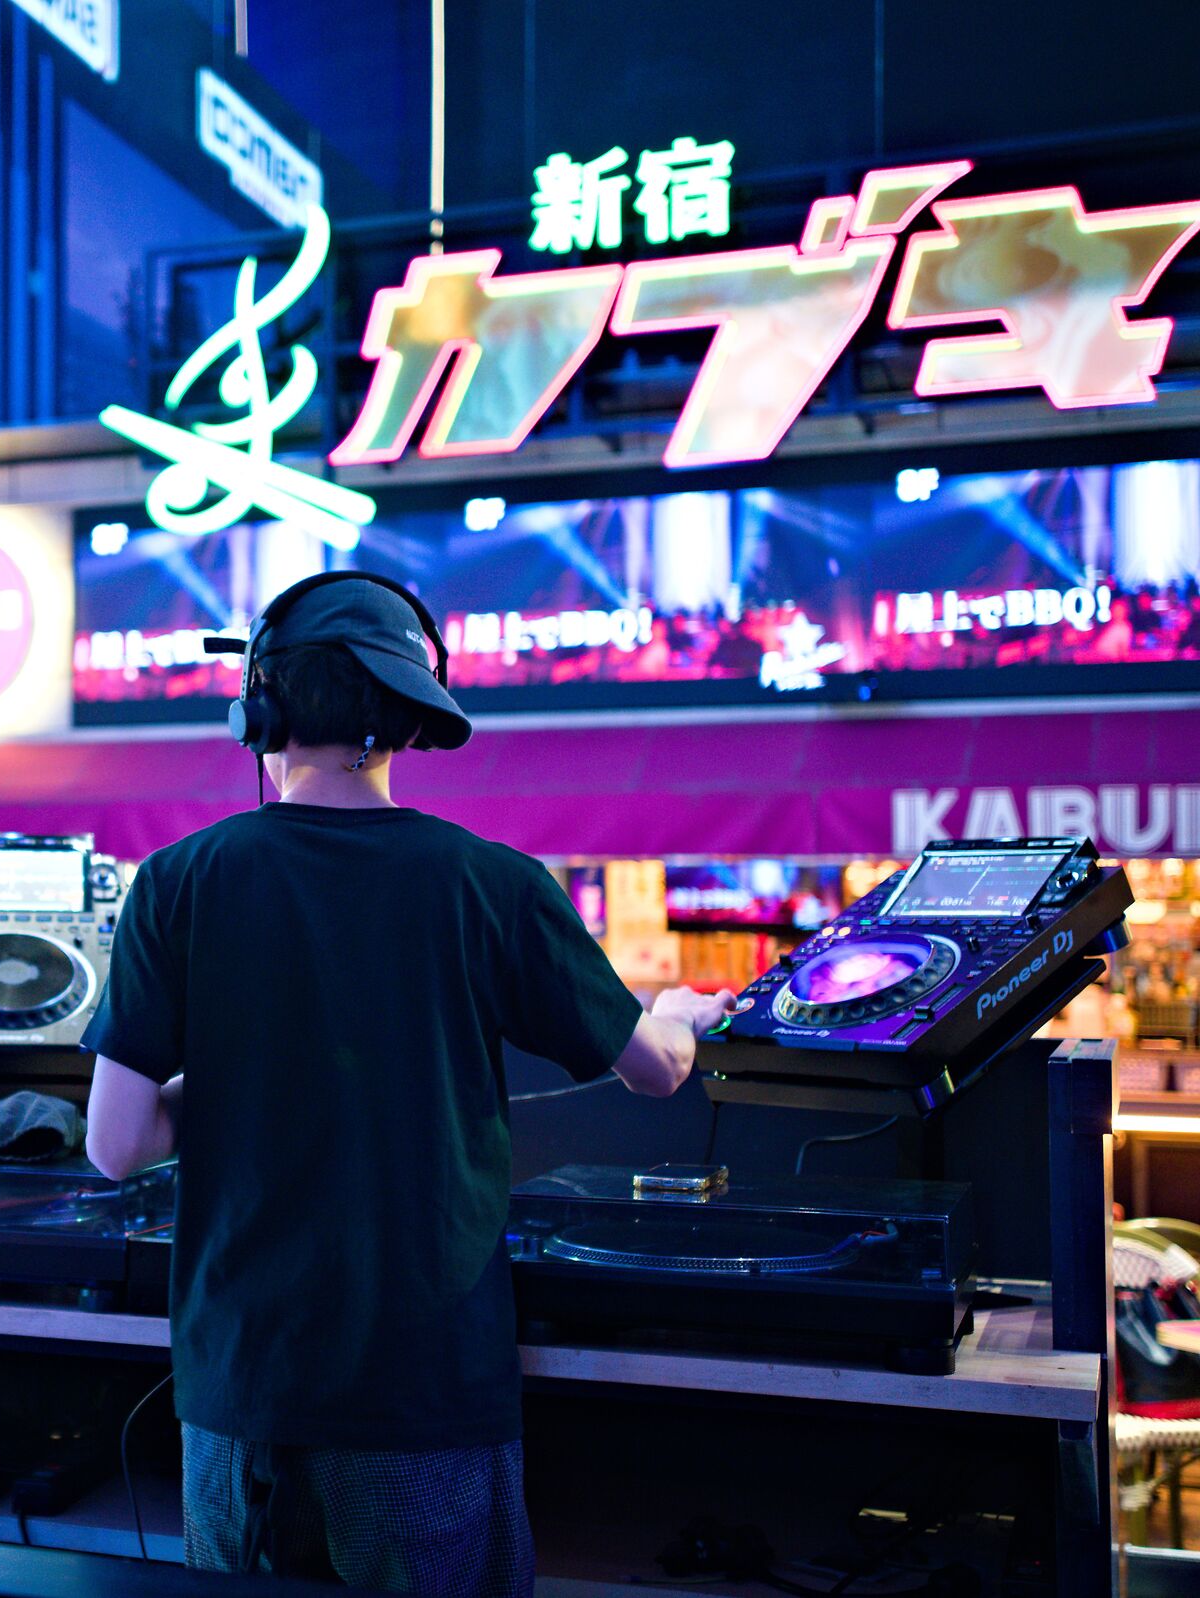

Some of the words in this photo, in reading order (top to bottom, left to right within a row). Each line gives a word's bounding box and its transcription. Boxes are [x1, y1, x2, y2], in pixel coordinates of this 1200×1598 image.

[528, 136, 735, 254] 新宿
[330, 160, 1200, 468] カブキ
[976, 949, 1050, 1020] Pioneer
[1052, 929, 1074, 955] DJ
